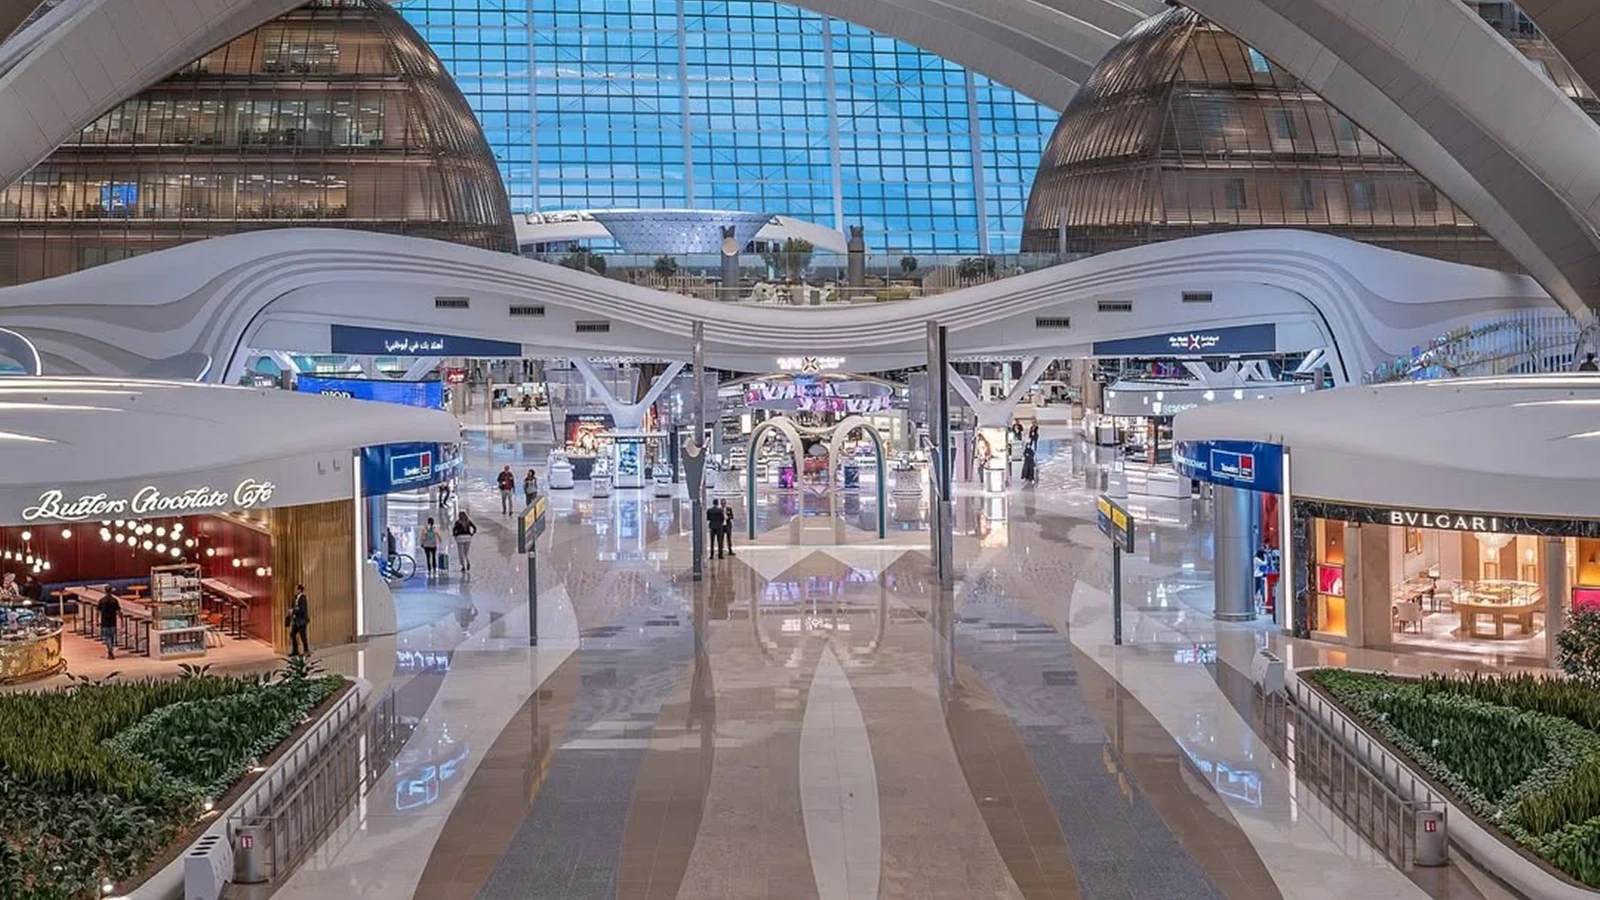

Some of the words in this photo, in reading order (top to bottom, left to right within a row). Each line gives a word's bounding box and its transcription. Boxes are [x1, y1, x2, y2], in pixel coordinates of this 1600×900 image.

[22, 490, 129, 520] Butlers
[131, 486, 229, 513] Chocolate
[233, 478, 276, 509] Café
[1390, 511, 1498, 531] BVLGARI
